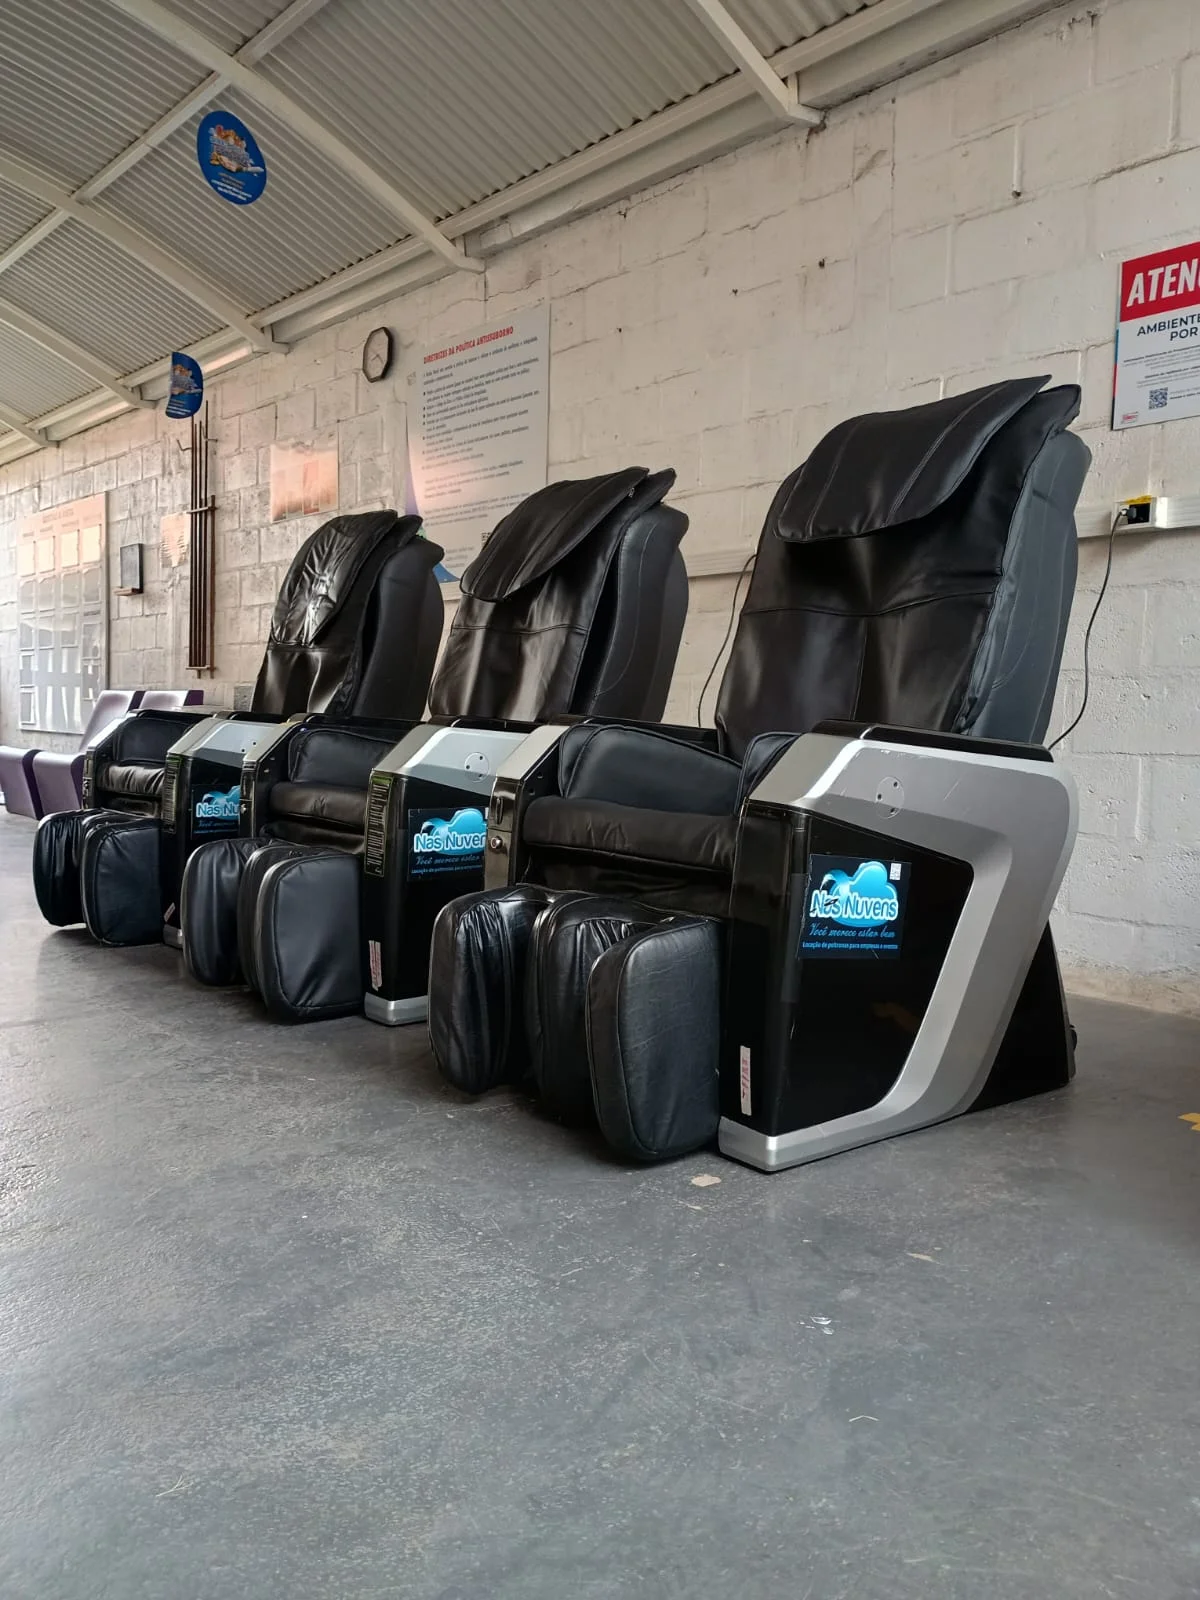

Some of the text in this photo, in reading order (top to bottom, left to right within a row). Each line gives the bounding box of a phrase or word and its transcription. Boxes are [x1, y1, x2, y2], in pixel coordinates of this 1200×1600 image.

[1126, 258, 1200, 307] ATEN
[1170, 326, 1198, 341] POR
[196, 802, 221, 817] Nas
[414, 832, 442, 852] Nas
[843, 892, 899, 920] Nuvens
[809, 922, 896, 938] Você merece estar bem
